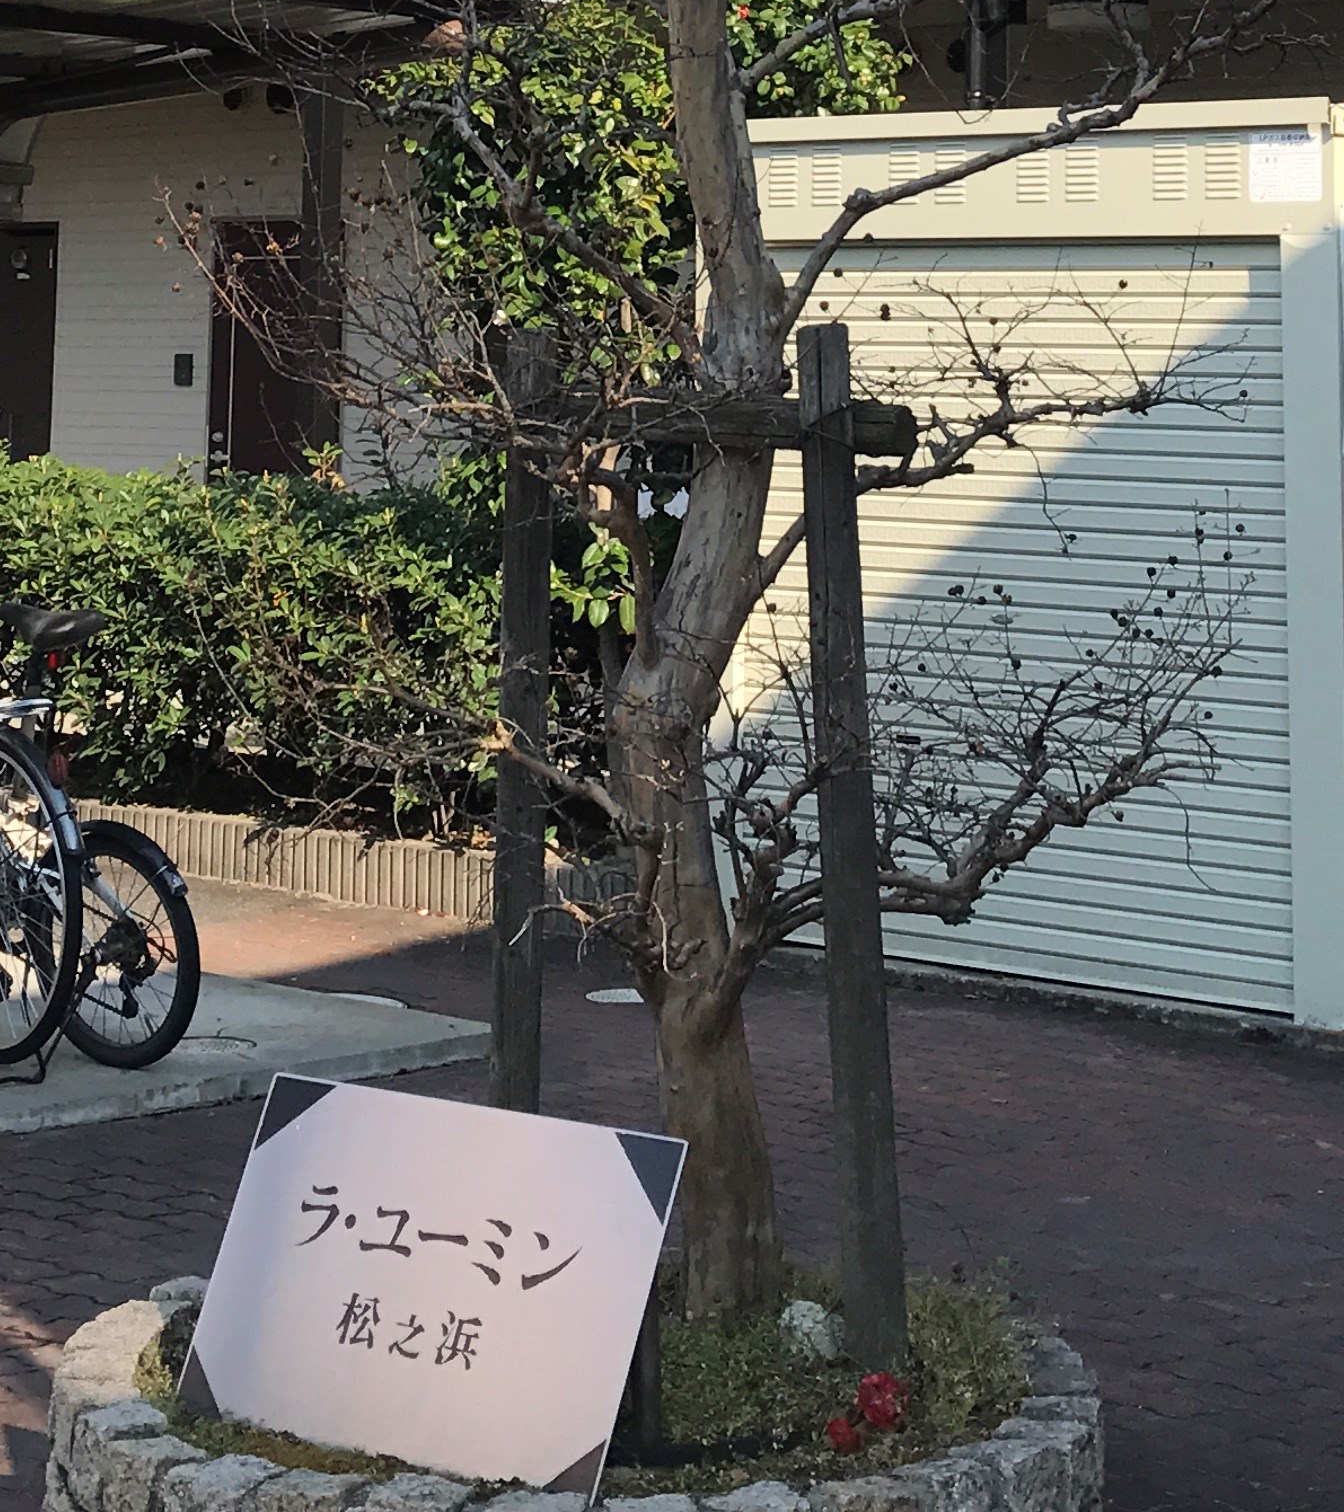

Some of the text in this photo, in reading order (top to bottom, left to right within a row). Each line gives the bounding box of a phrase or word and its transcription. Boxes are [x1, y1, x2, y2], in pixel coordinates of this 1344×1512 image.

[294, 1184, 583, 1291] ラ・ユーミン
[336, 1291, 483, 1370] 松之浜
